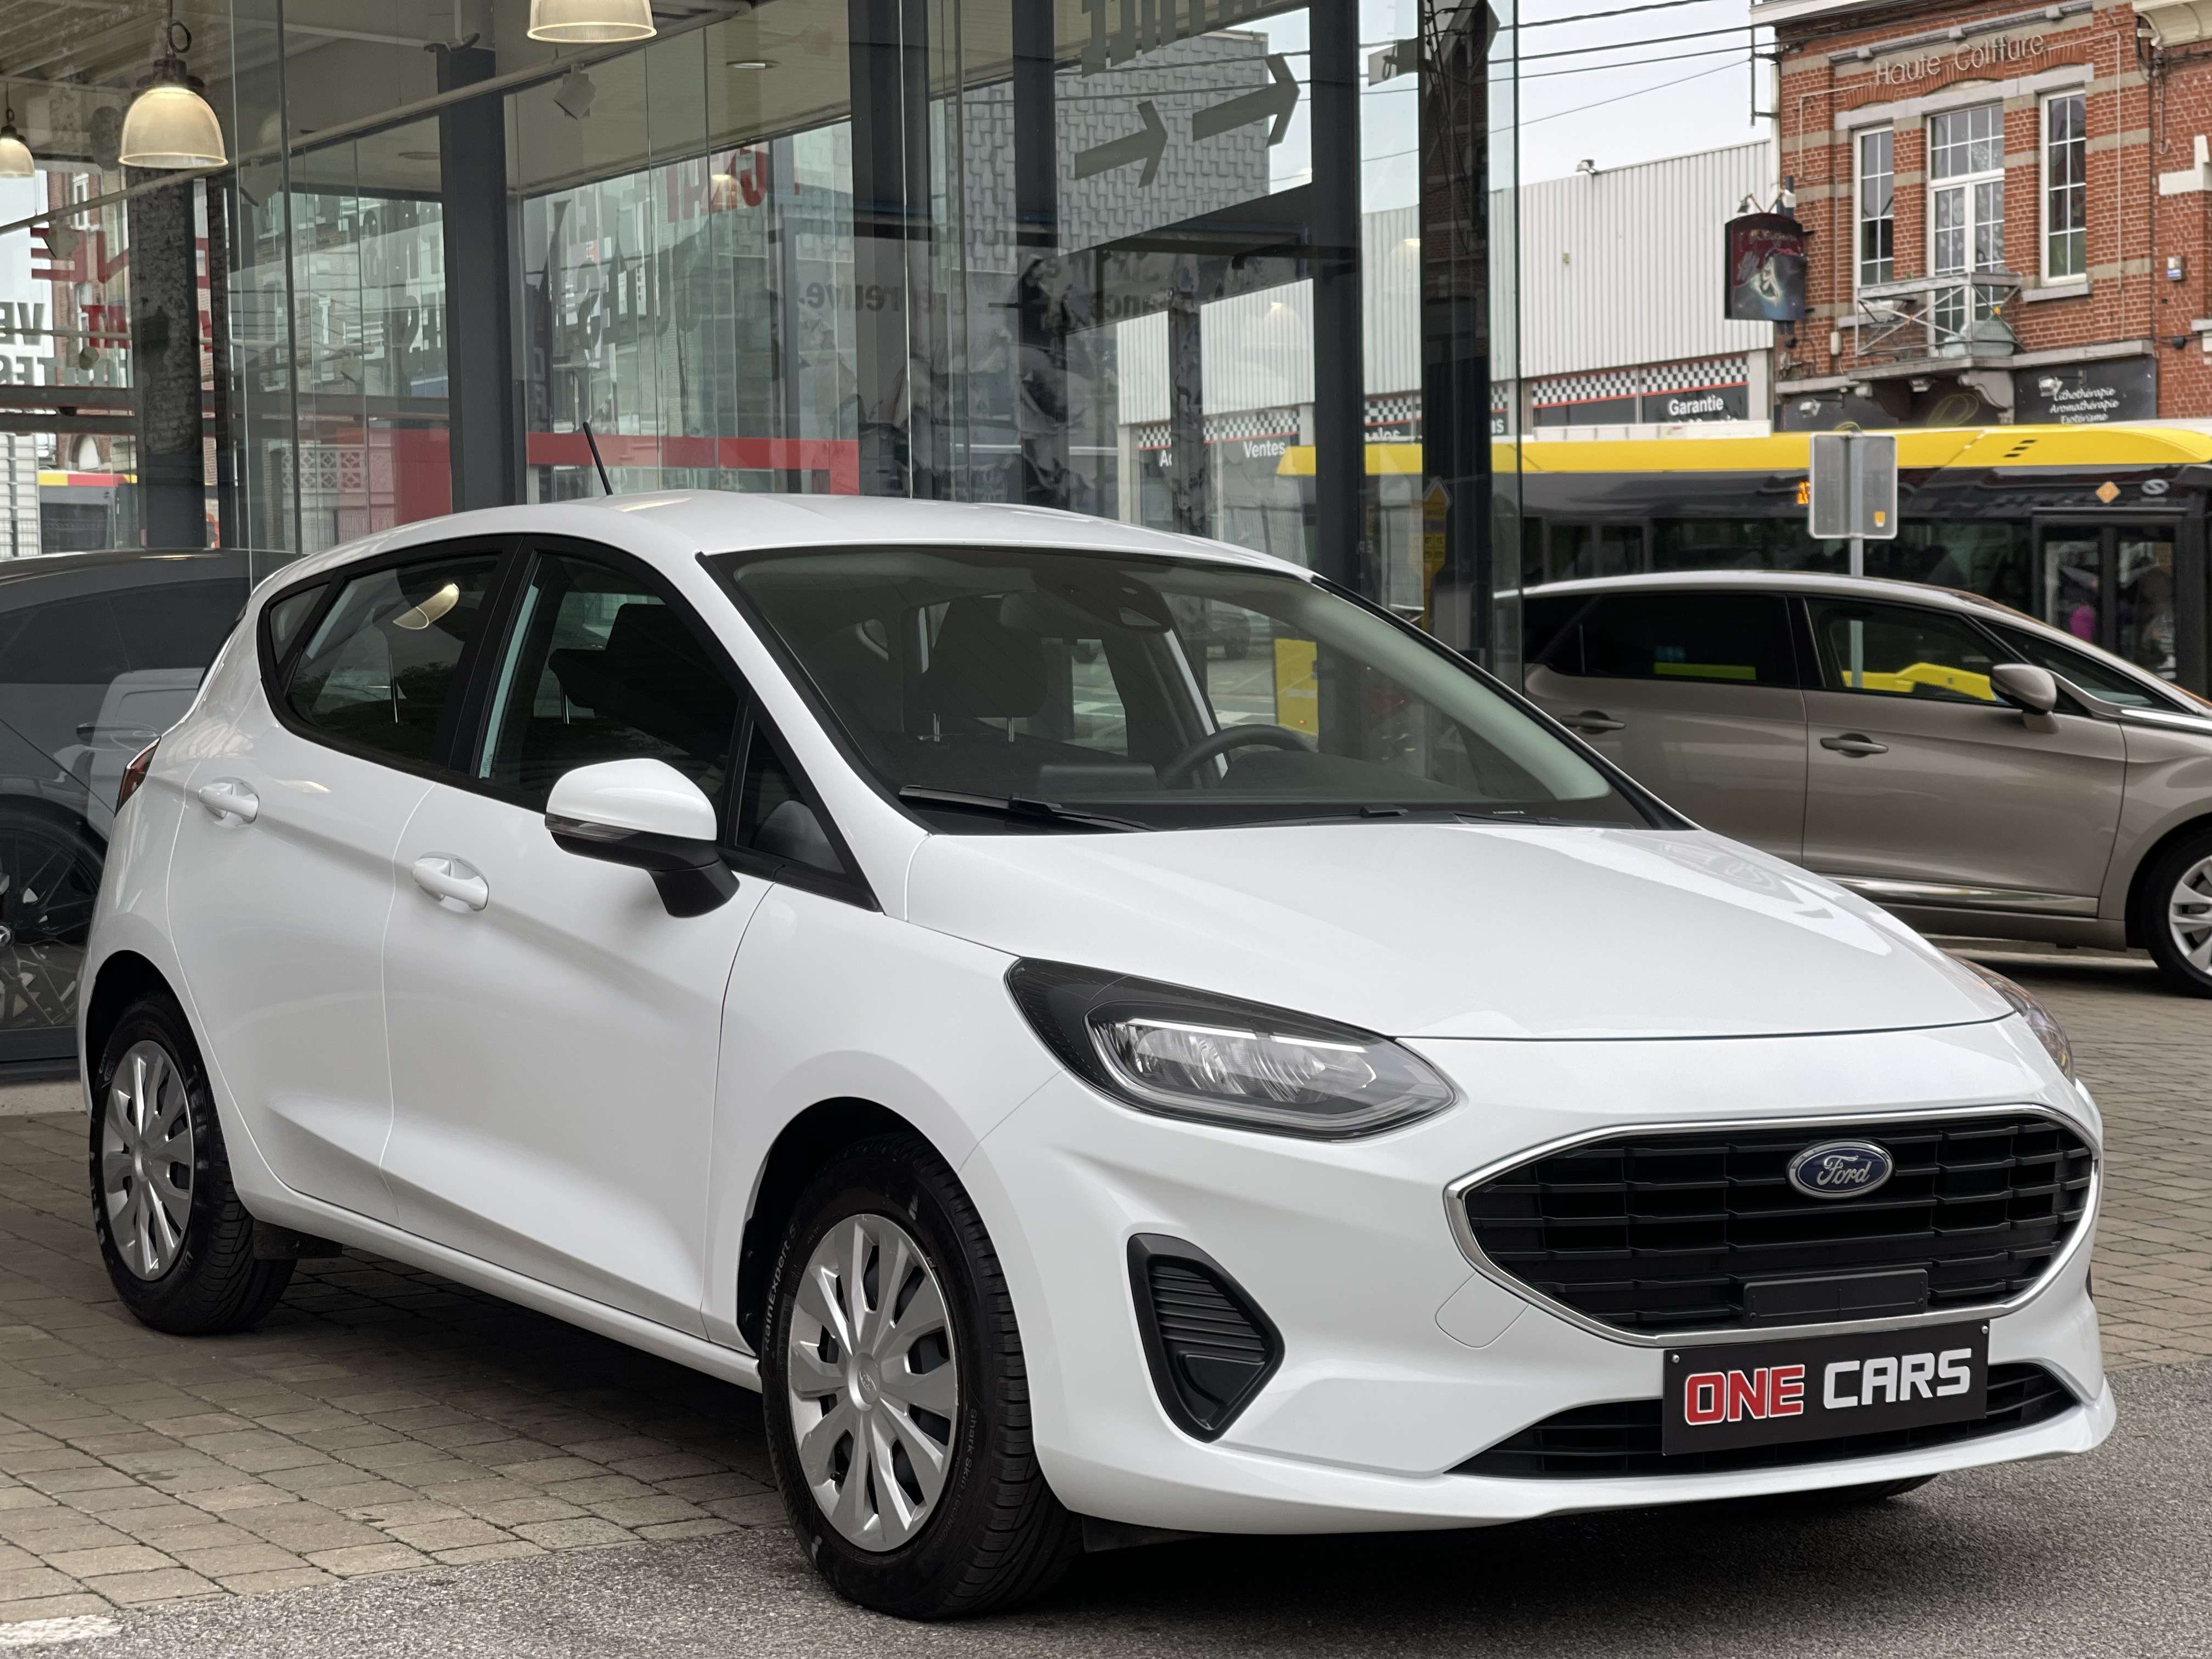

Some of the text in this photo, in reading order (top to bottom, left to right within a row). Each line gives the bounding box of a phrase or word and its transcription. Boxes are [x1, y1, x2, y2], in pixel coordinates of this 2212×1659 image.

[1876, 35, 2045, 87] Haute Coiffure
[1668, 394, 1724, 416] Garantie
[1243, 440, 1285, 458] Ventes
[1816, 1154, 1872, 1186] Ford
[1684, 1347, 1972, 1426] ONE CARS
